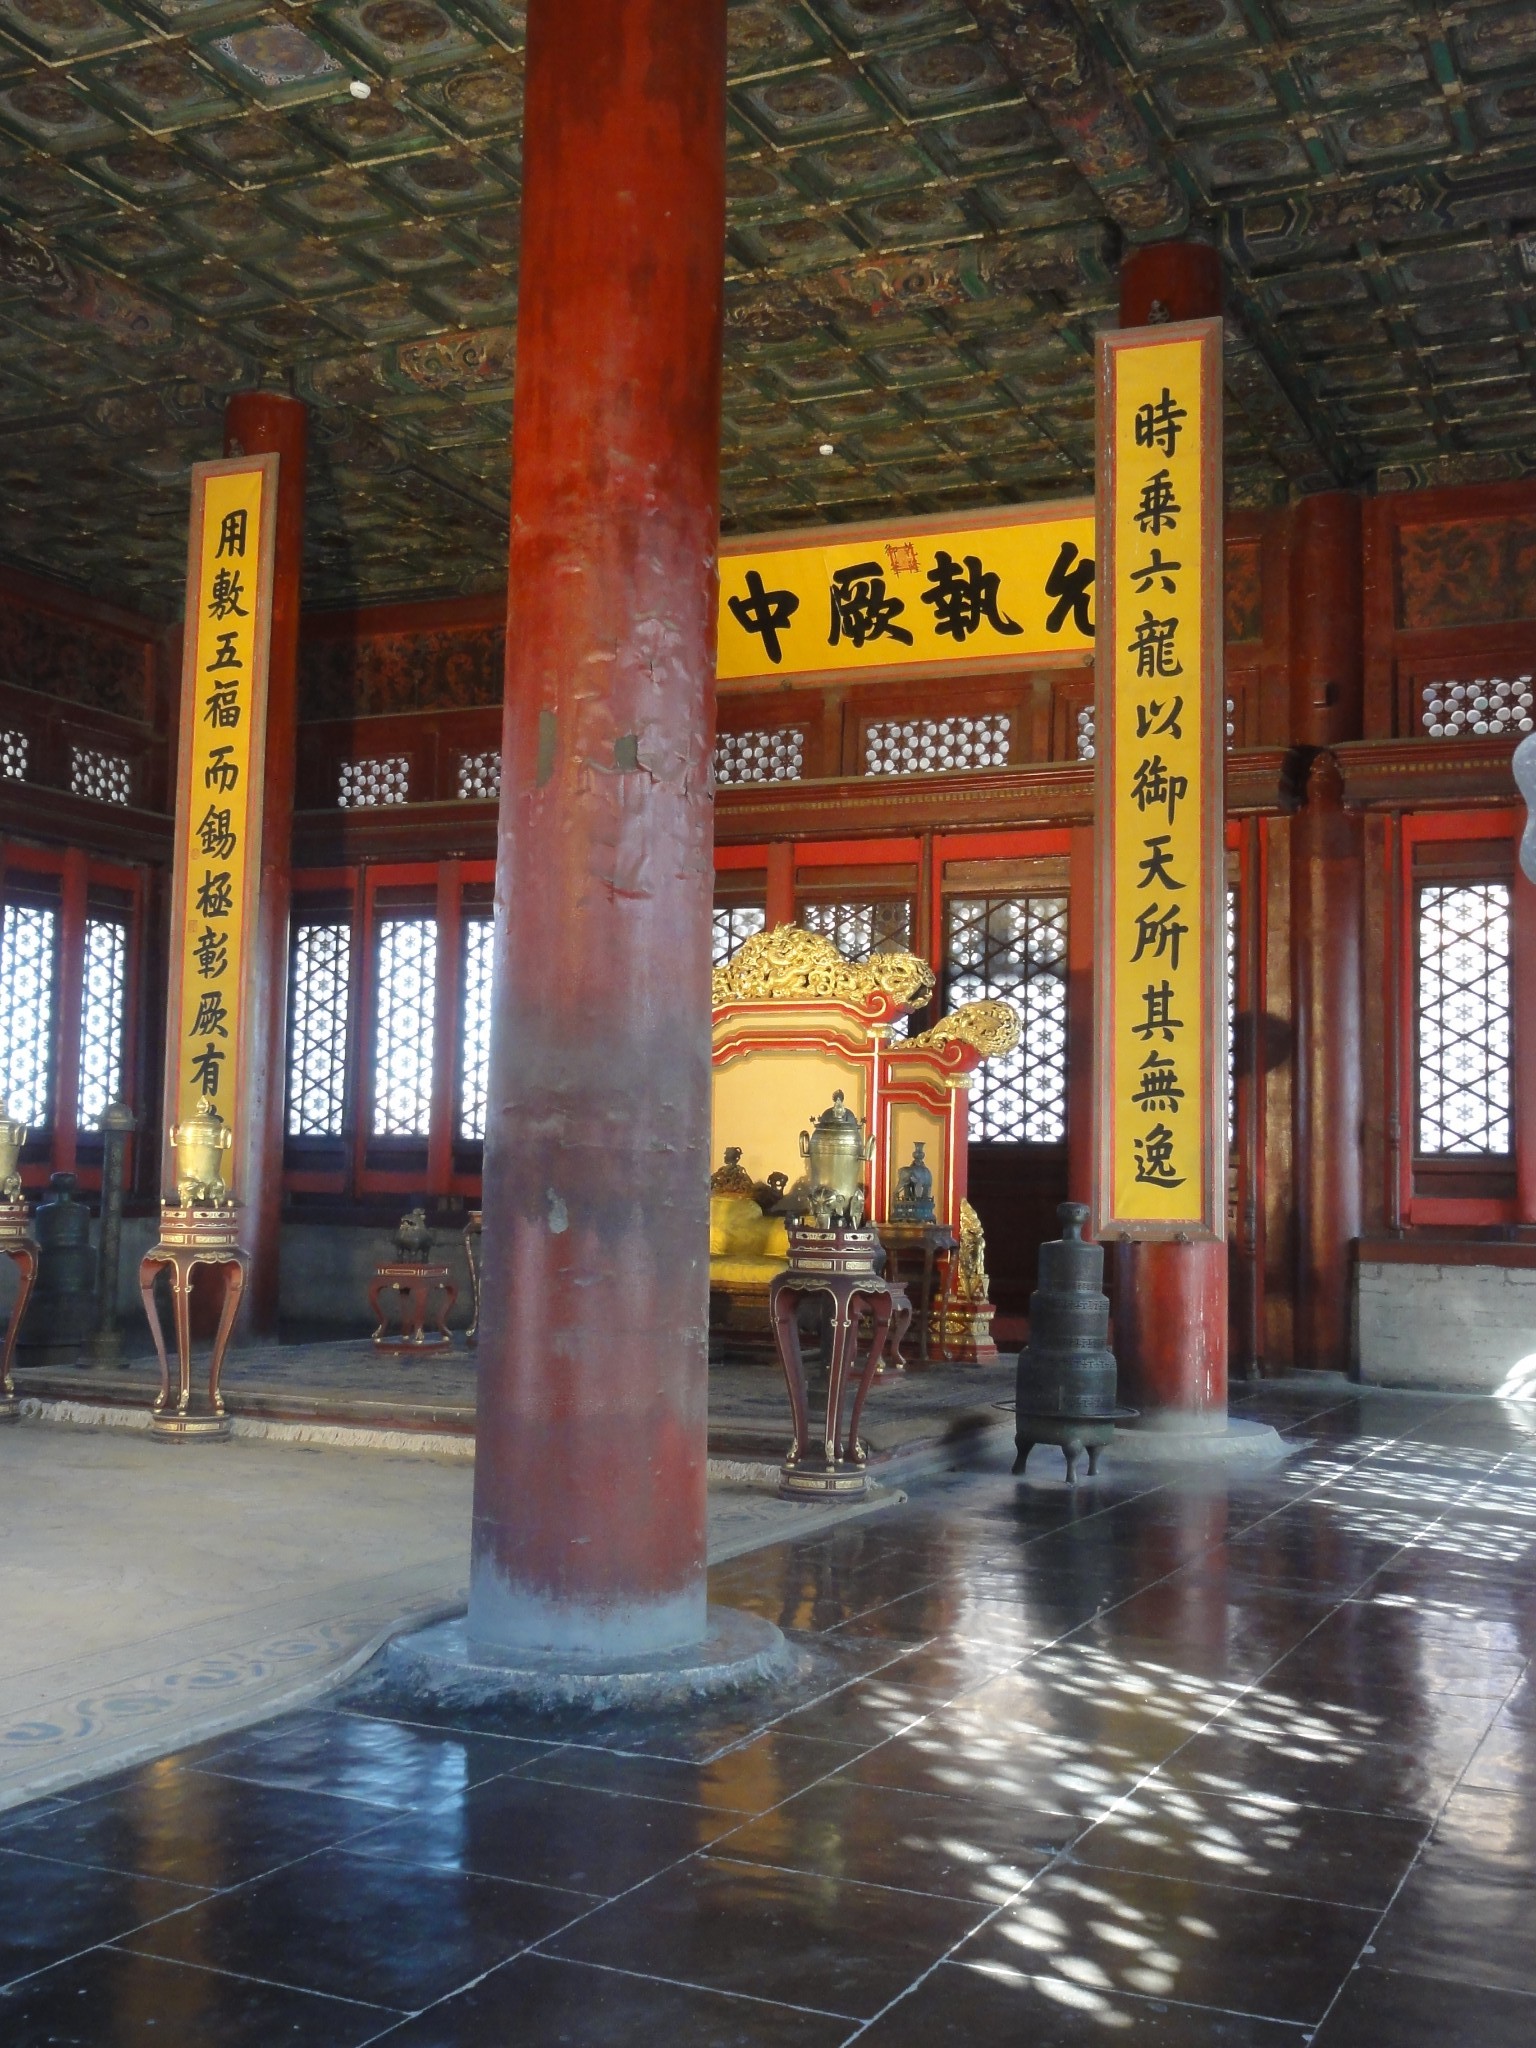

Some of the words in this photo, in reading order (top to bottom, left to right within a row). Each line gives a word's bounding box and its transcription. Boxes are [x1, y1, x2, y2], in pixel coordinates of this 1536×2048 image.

[188, 508, 249, 1123] 用敷五福而錫極彰厥有
